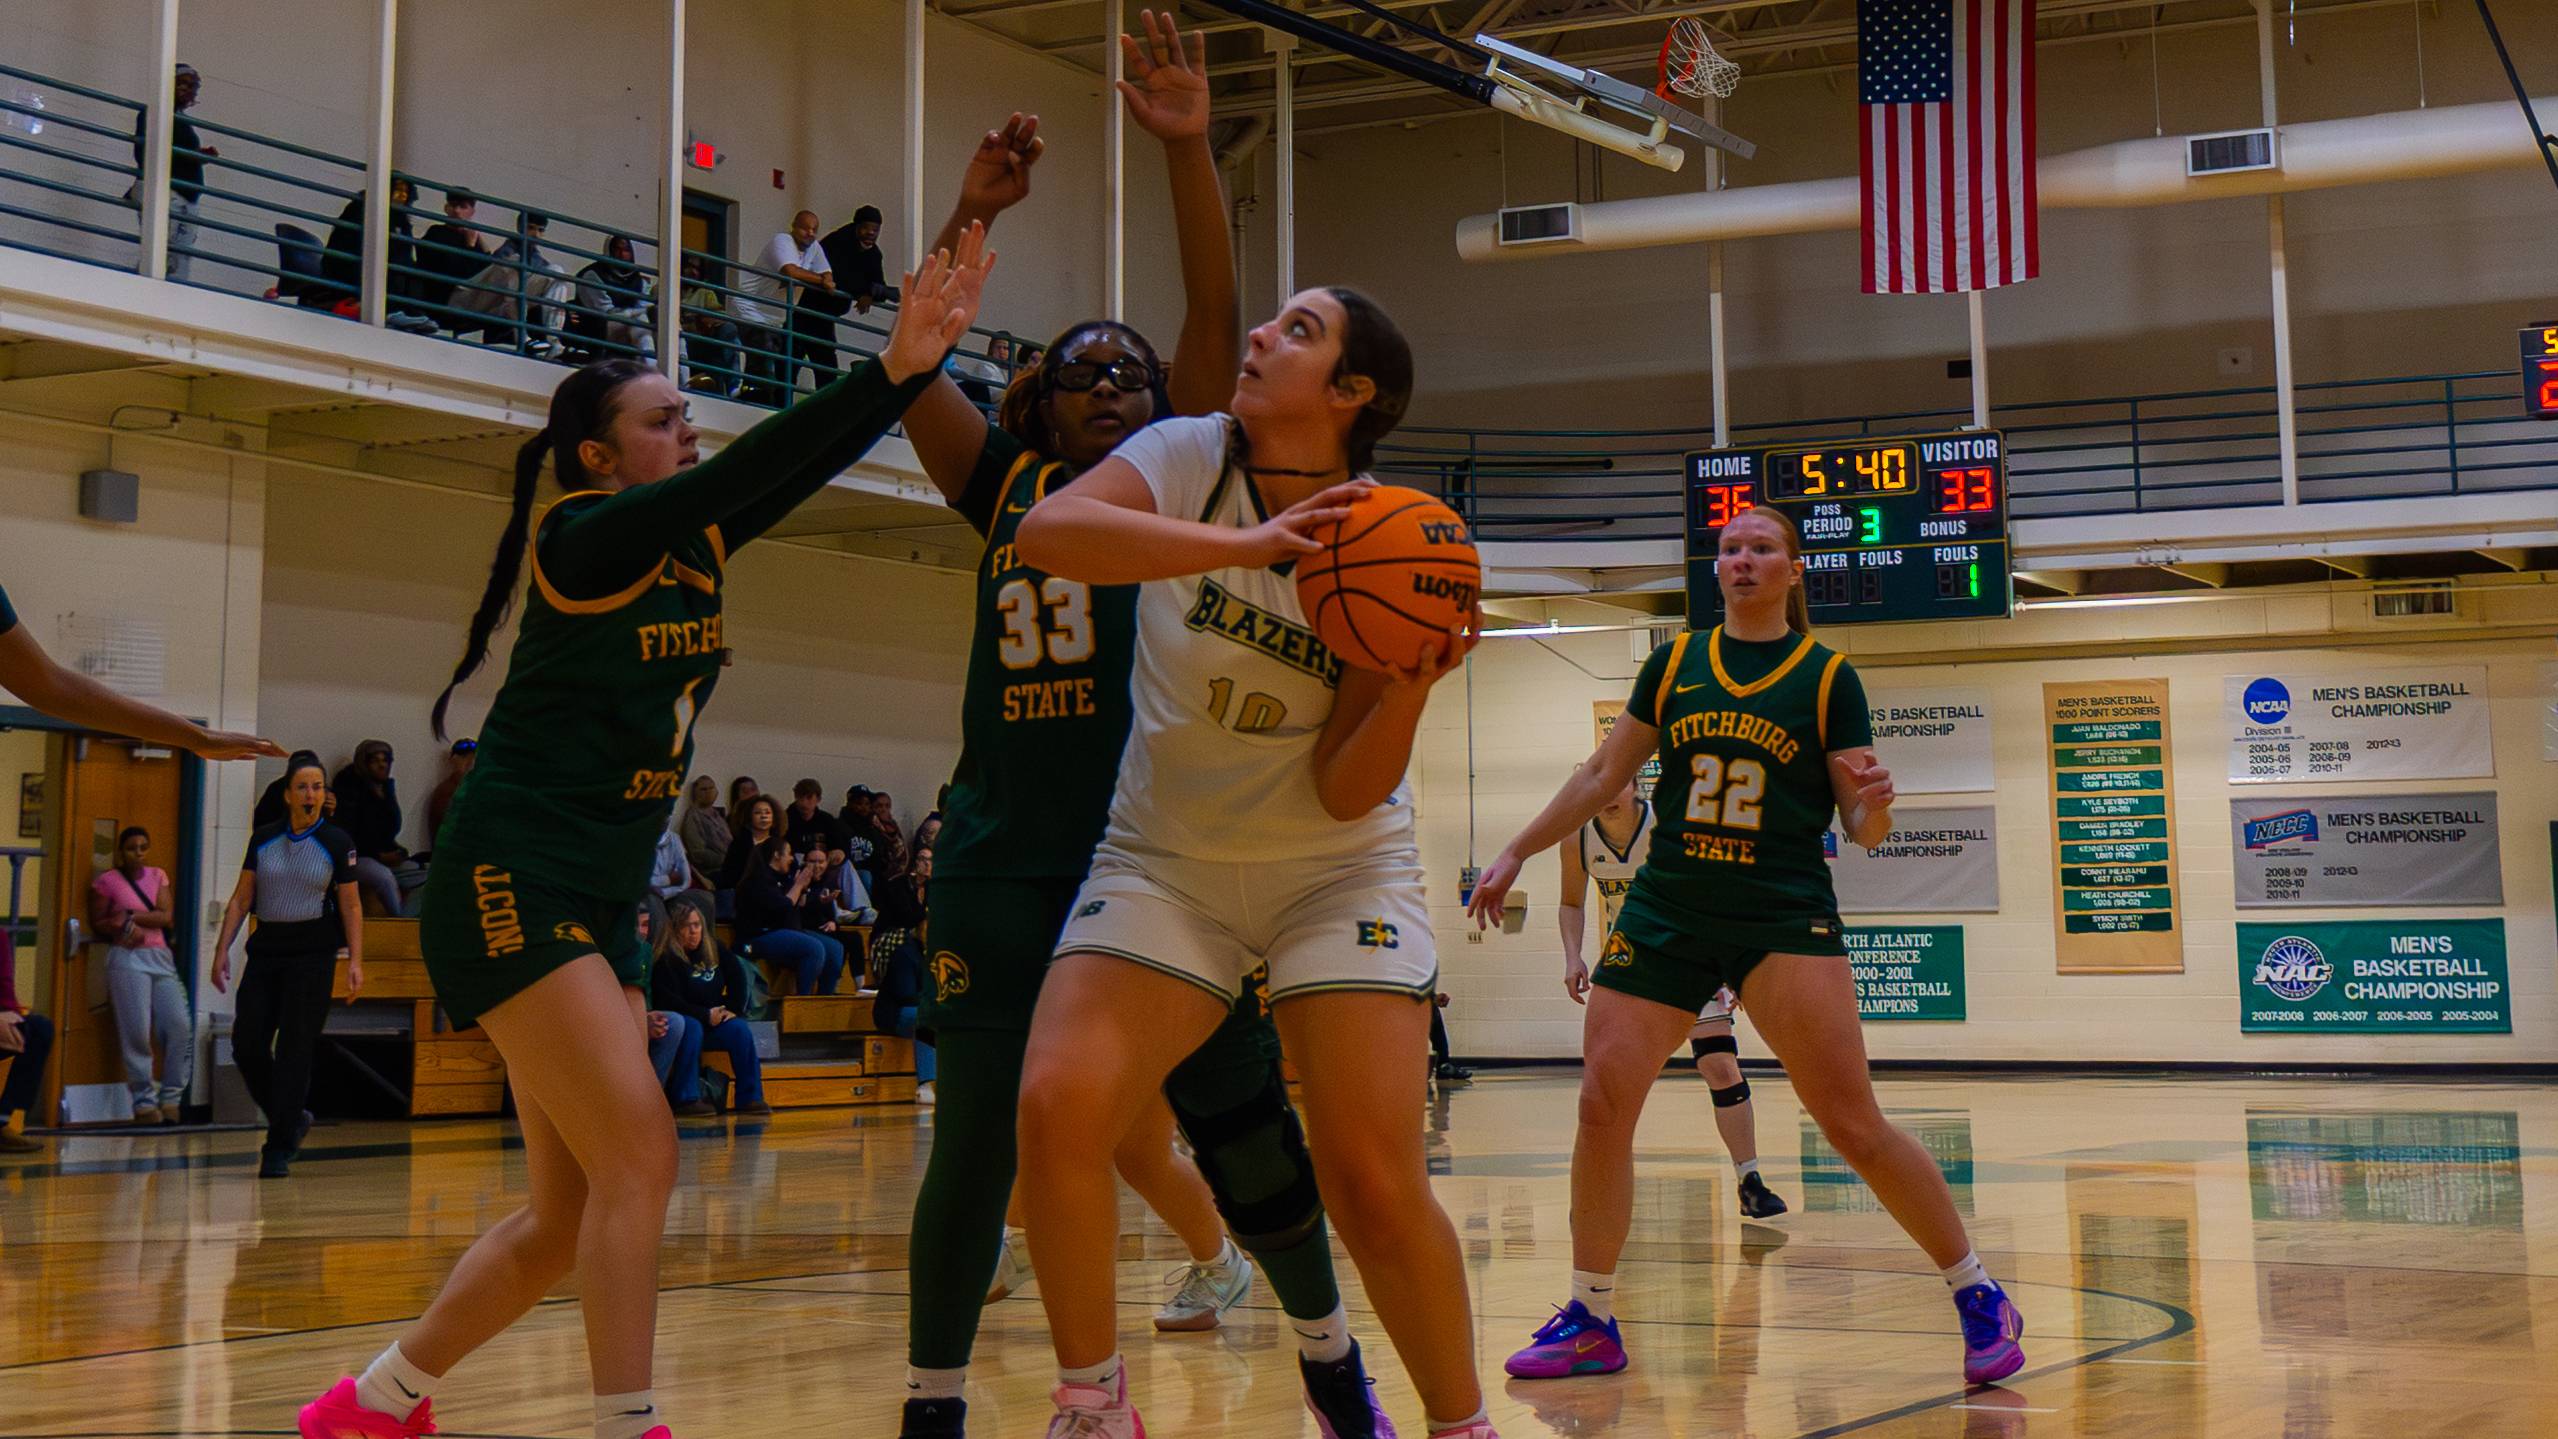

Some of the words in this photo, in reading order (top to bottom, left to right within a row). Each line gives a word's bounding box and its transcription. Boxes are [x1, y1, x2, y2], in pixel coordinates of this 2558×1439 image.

[1921, 439, 1998, 463] VISITOR
[1697, 456, 1751, 478] HOME
[1801, 448, 1906, 495] 5:40
[1940, 468, 1992, 512] 33
[1814, 503, 1841, 516] POSS
[1803, 517, 1853, 533] PERIOD
[1860, 507, 1880, 542] 3
[1920, 520, 1967, 537] BONUS
[1859, 550, 1903, 567] FOULS
[1934, 546, 1979, 563] FOULS
[1968, 563, 1979, 598] 1
[997, 577, 1096, 670] 33
[1185, 577, 1345, 688] BLAZERS
[1003, 678, 1095, 721] STATE
[2313, 686, 2360, 701] MEN'S
[2364, 683, 2470, 699] BASKETBALL
[1208, 677, 1287, 732] 10
[2058, 698, 2088, 707] MEN'S
[2090, 696, 2155, 706] BASKETBALL
[2250, 700, 2289, 714] NCAA
[2331, 701, 2452, 718] CHAMPIONSHIP
[1890, 705, 1984, 720] BASKETBALL
[2056, 708, 2078, 718] 1000
[2080, 708, 2110, 718] POINT
[2112, 706, 2160, 716] SCORERS
[1670, 711, 1799, 764] FITCHBURG
[2309, 763, 2343, 773] 2010-11
[1684, 753, 1766, 830] 22
[2253, 814, 2309, 842] NECC
[2328, 812, 2374, 828] MEN'S
[2379, 810, 2484, 826] BASKETBALL
[1904, 829, 1987, 842] BASKETBALL
[2345, 829, 2466, 844] CHAMPIONSHIP
[1682, 832, 1756, 864] STATE
[1867, 845, 1963, 859] CHAMPIONSHIP
[1872, 933, 1933, 947] ATLANTIC
[2390, 936, 2452, 954] MEN'S
[2253, 964, 2333, 983] NAC
[2353, 959, 2488, 977] BASKETBALL
[1868, 982, 1952, 996] BASKETBALL
[2344, 981, 2500, 1000] CHAMPIONSHIP
